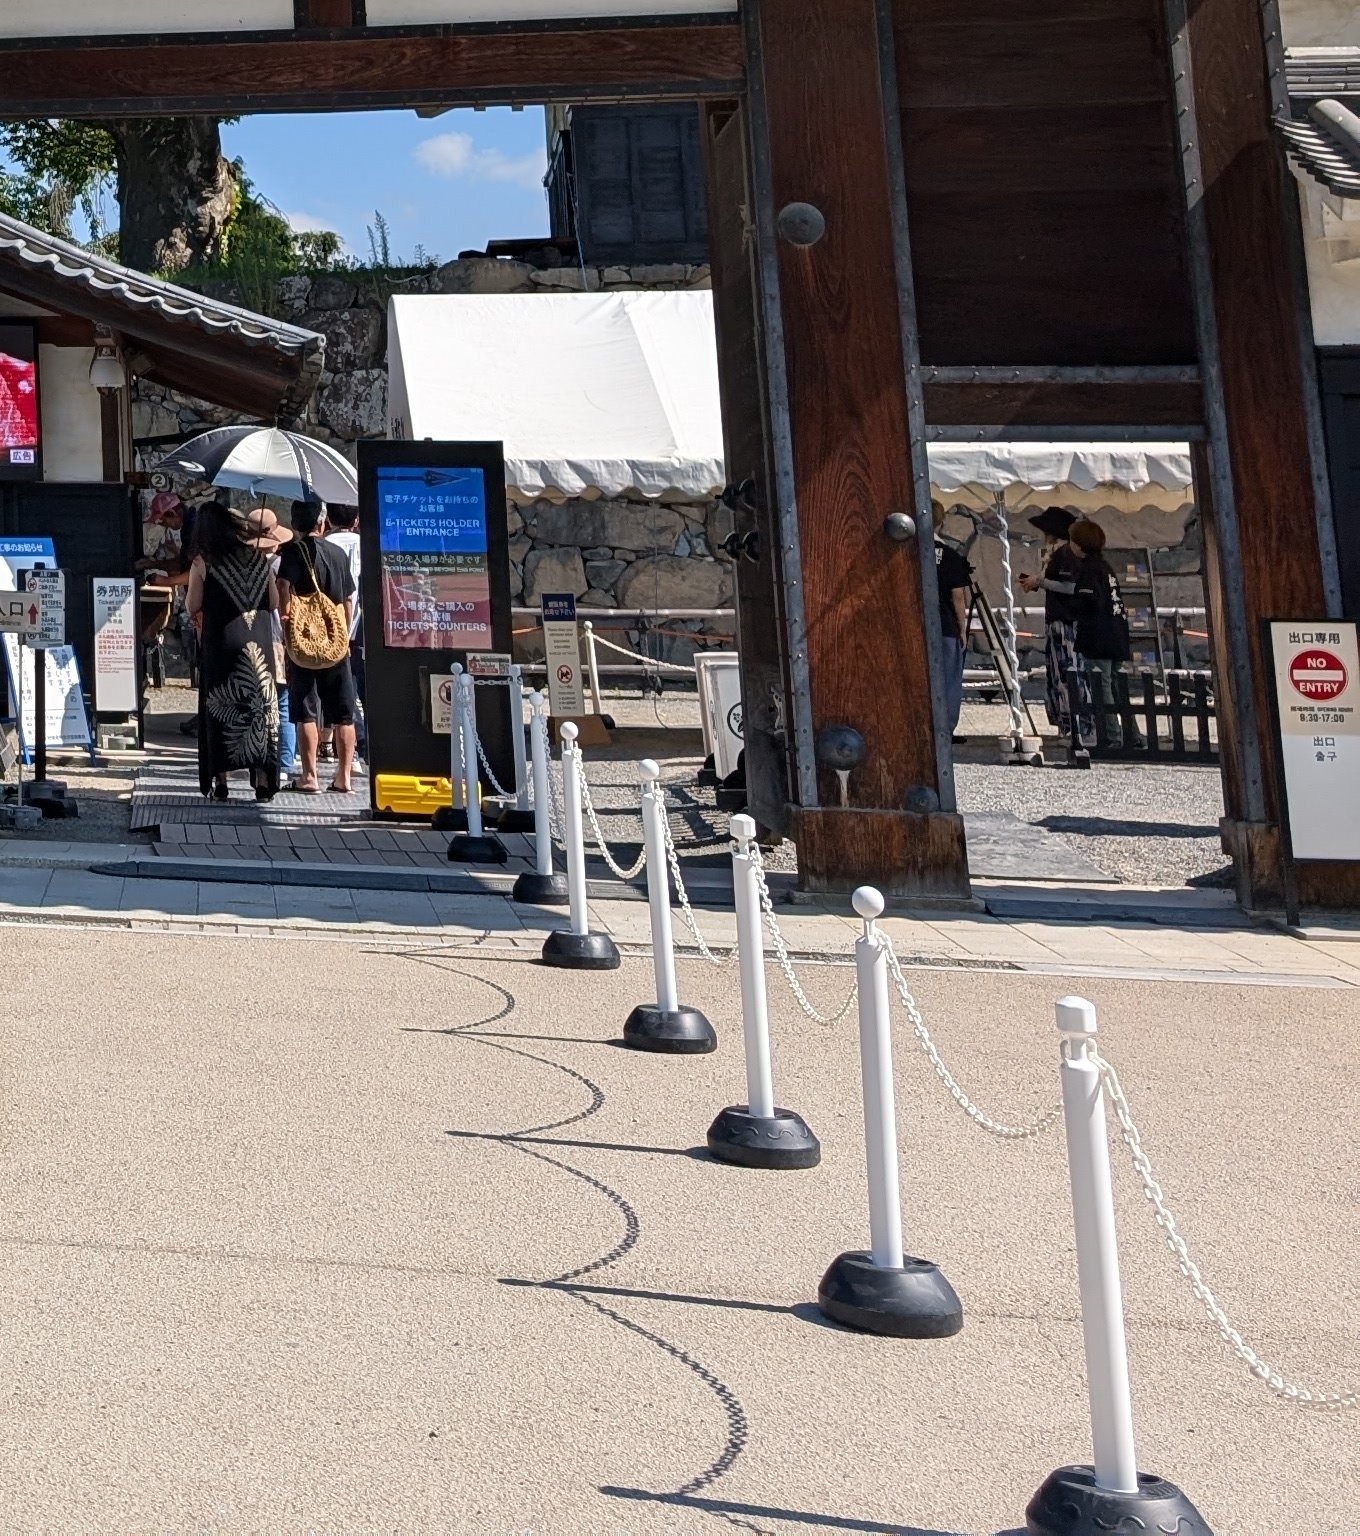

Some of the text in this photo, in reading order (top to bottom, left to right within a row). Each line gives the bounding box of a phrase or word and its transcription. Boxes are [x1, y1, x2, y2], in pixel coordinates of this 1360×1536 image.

[385, 518, 480, 528] E-TICKETS HOLDER
[406, 527, 460, 537] ENTRANCE
[96, 584, 133, 598] 券売所
[387, 620, 487, 632] TICKETS COUNTERS
[1288, 631, 1341, 645] 出口専用
[1306, 657, 1327, 668] NO
[1299, 682, 1340, 693] ENTRY
[1313, 736, 1336, 747] 出口
